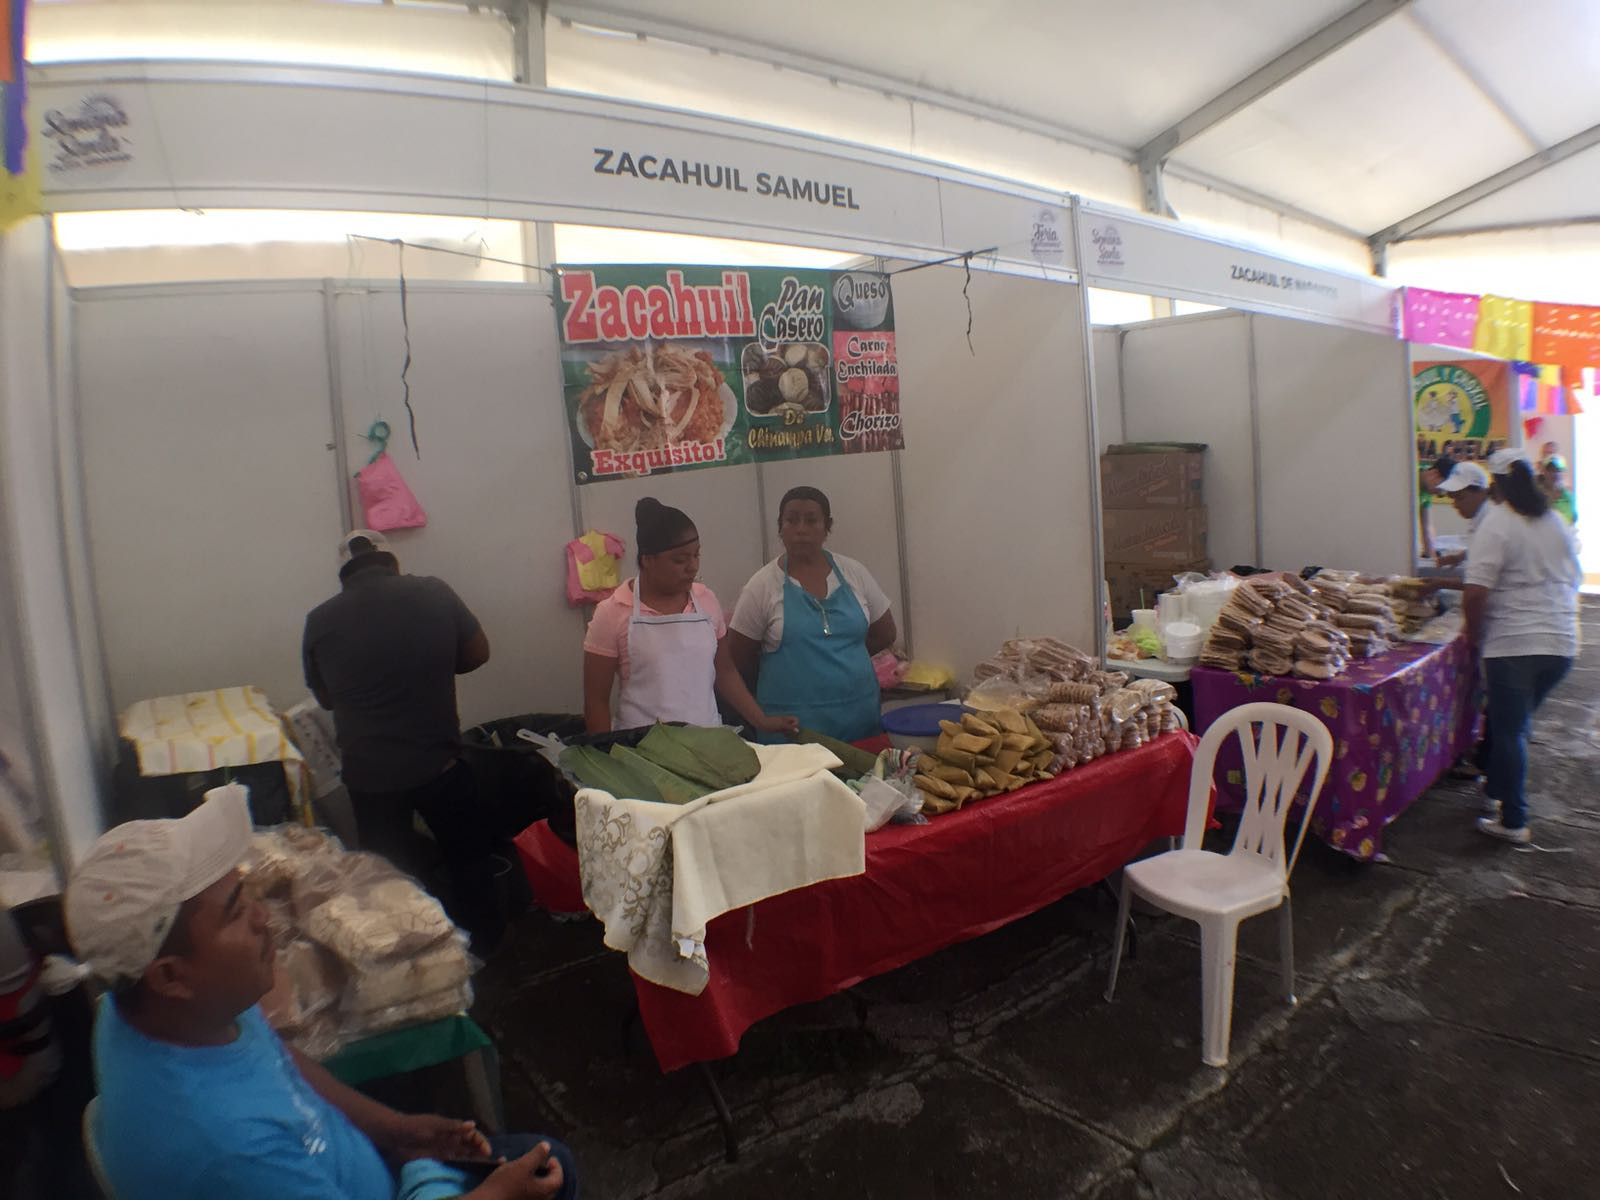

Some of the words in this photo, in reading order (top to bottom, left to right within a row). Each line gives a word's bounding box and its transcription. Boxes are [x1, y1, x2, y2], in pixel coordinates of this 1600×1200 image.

[594, 148, 748, 193] ZACAHUIL
[756, 172, 860, 210] SAMUEL
[560, 271, 757, 343] Zacahuil
[776, 276, 825, 314] Pan
[837, 273, 888, 312] Queso
[759, 302, 825, 353] Casero
[839, 408, 900, 440] Chorizo
[591, 438, 726, 475] Exquisito!
